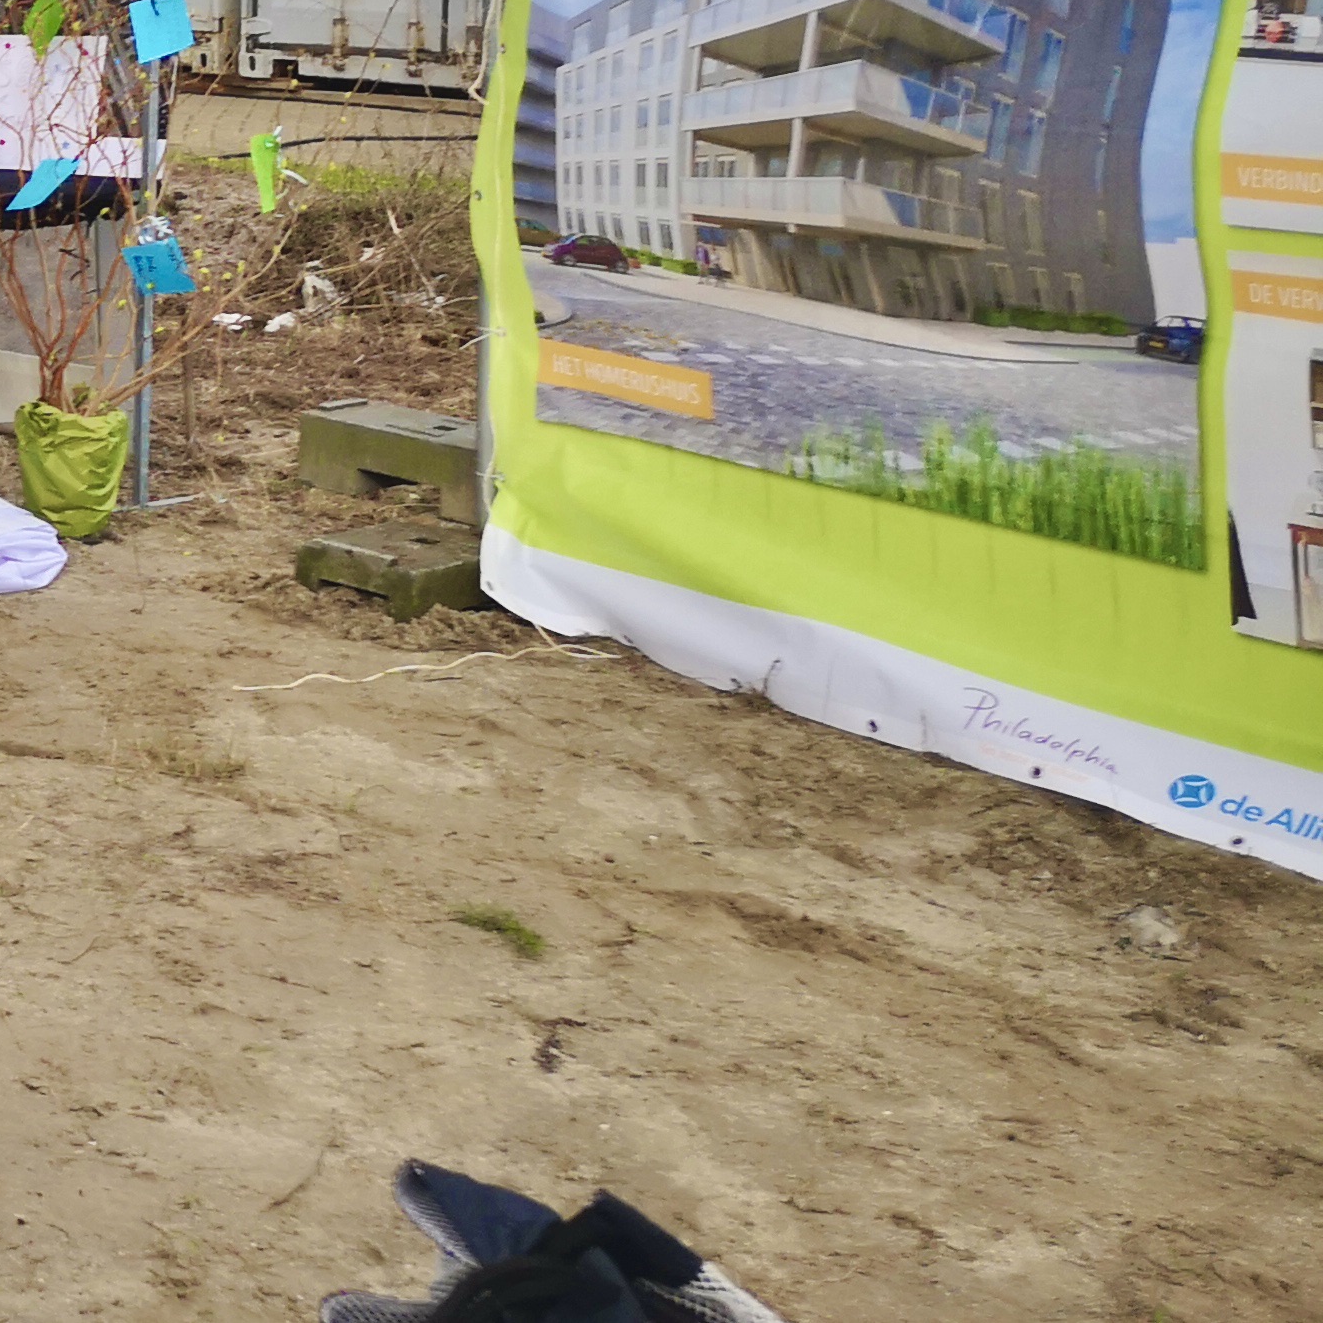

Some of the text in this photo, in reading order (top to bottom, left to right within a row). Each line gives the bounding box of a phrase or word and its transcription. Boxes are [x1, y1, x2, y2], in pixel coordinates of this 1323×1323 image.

[1248, 282, 1274, 305] DE
[552, 354, 700, 404] HET HOMERUSHUIS
[1218, 795, 1323, 841] de Alli
